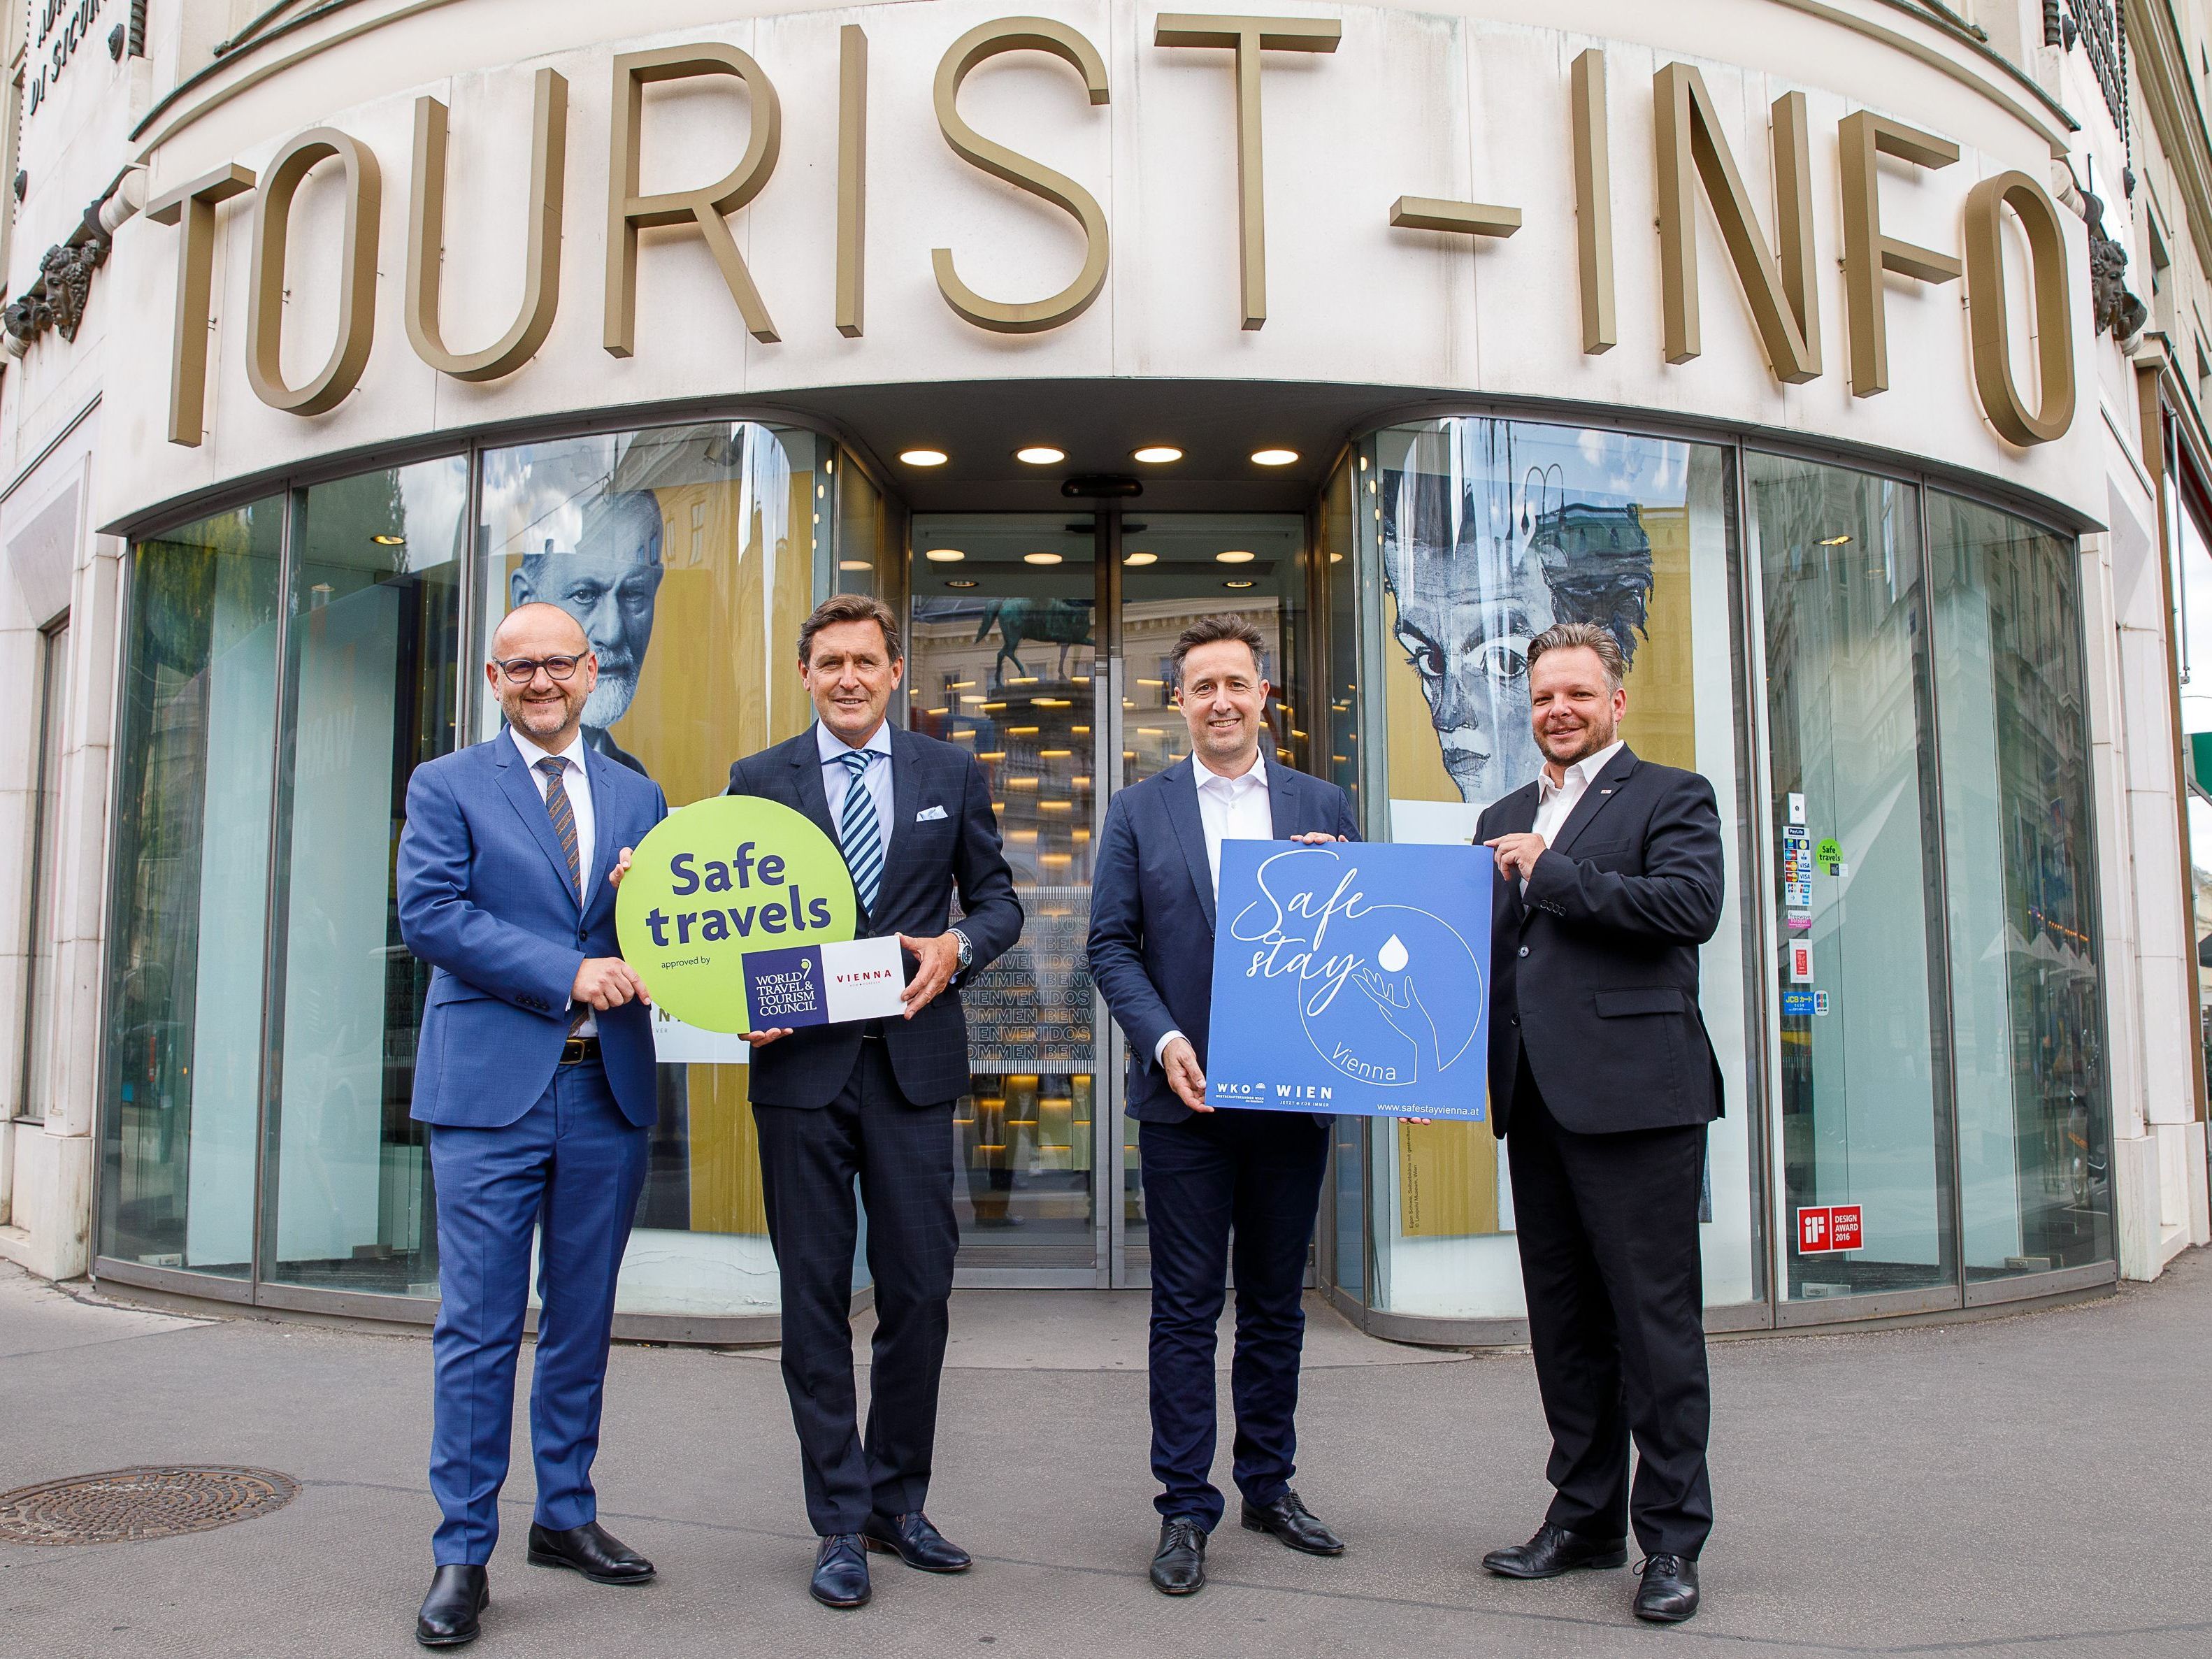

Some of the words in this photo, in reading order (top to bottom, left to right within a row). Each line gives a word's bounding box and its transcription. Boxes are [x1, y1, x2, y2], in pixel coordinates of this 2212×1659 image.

[150, 14, 2076, 448] TOURIST-INFO
[670, 842, 785, 896] Safe
[1230, 849, 1373, 951] Safe
[646, 884, 831, 947] travels
[661, 957, 698, 970] approved
[701, 956, 711, 966] by
[985, 954, 1089, 969] NVENIDOS
[755, 972, 803, 986] WORLD
[837, 970, 891, 983] VIENNA
[1246, 931, 1365, 1017] stay
[756, 982, 804, 996] TRAVEL
[805, 982, 813, 990] &
[757, 991, 814, 1007] TOURISM
[961, 990, 1090, 1005] BIENVENIDOS
[759, 1001, 817, 1017] COUNCIL
[964, 1009, 1037, 1023] OMMEN
[968, 1044, 1037, 1059] OMMEN
[1332, 1041, 1397, 1081] Vienna
[1217, 1083, 1251, 1094] WKO
[1276, 1084, 1332, 1099] WIEN
[1377, 1103, 1479, 1116] www.safestayvienna.at
[1834, 1214, 1858, 1223] DESIGN
[1834, 1223, 1859, 1233] AWARD
[1835, 1233, 1851, 1242] 2016
